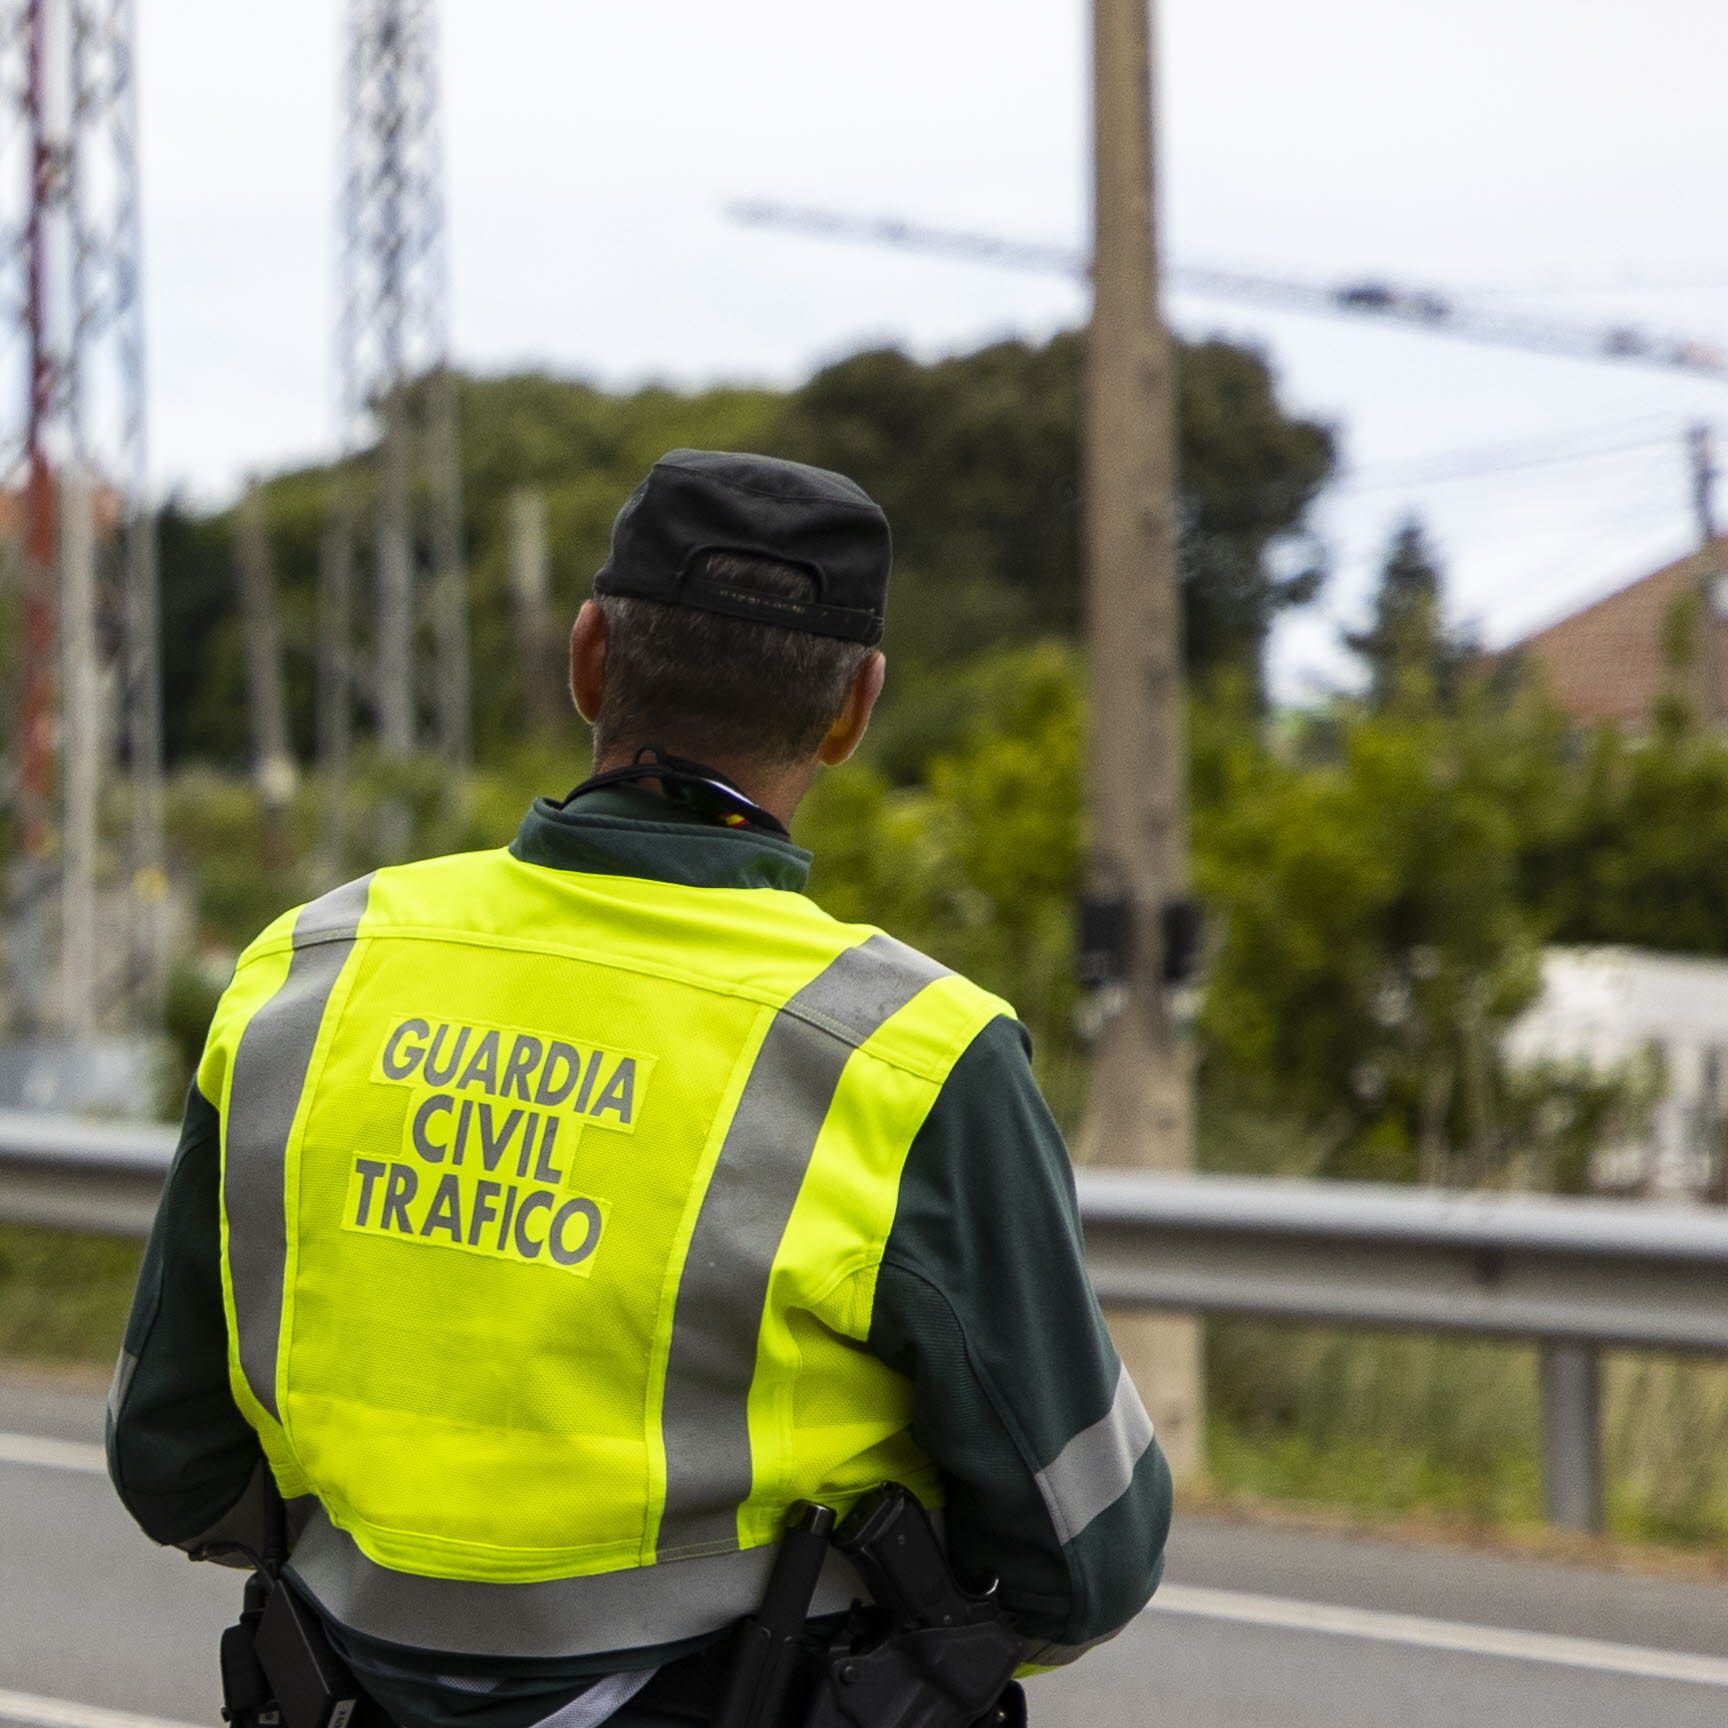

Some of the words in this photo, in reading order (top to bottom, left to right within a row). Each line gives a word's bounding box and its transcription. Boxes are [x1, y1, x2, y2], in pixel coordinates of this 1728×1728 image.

[381, 1017, 637, 1125] GUARDIA
[411, 1093, 563, 1185] CIVIL
[354, 1158, 603, 1266] TRAFICO
